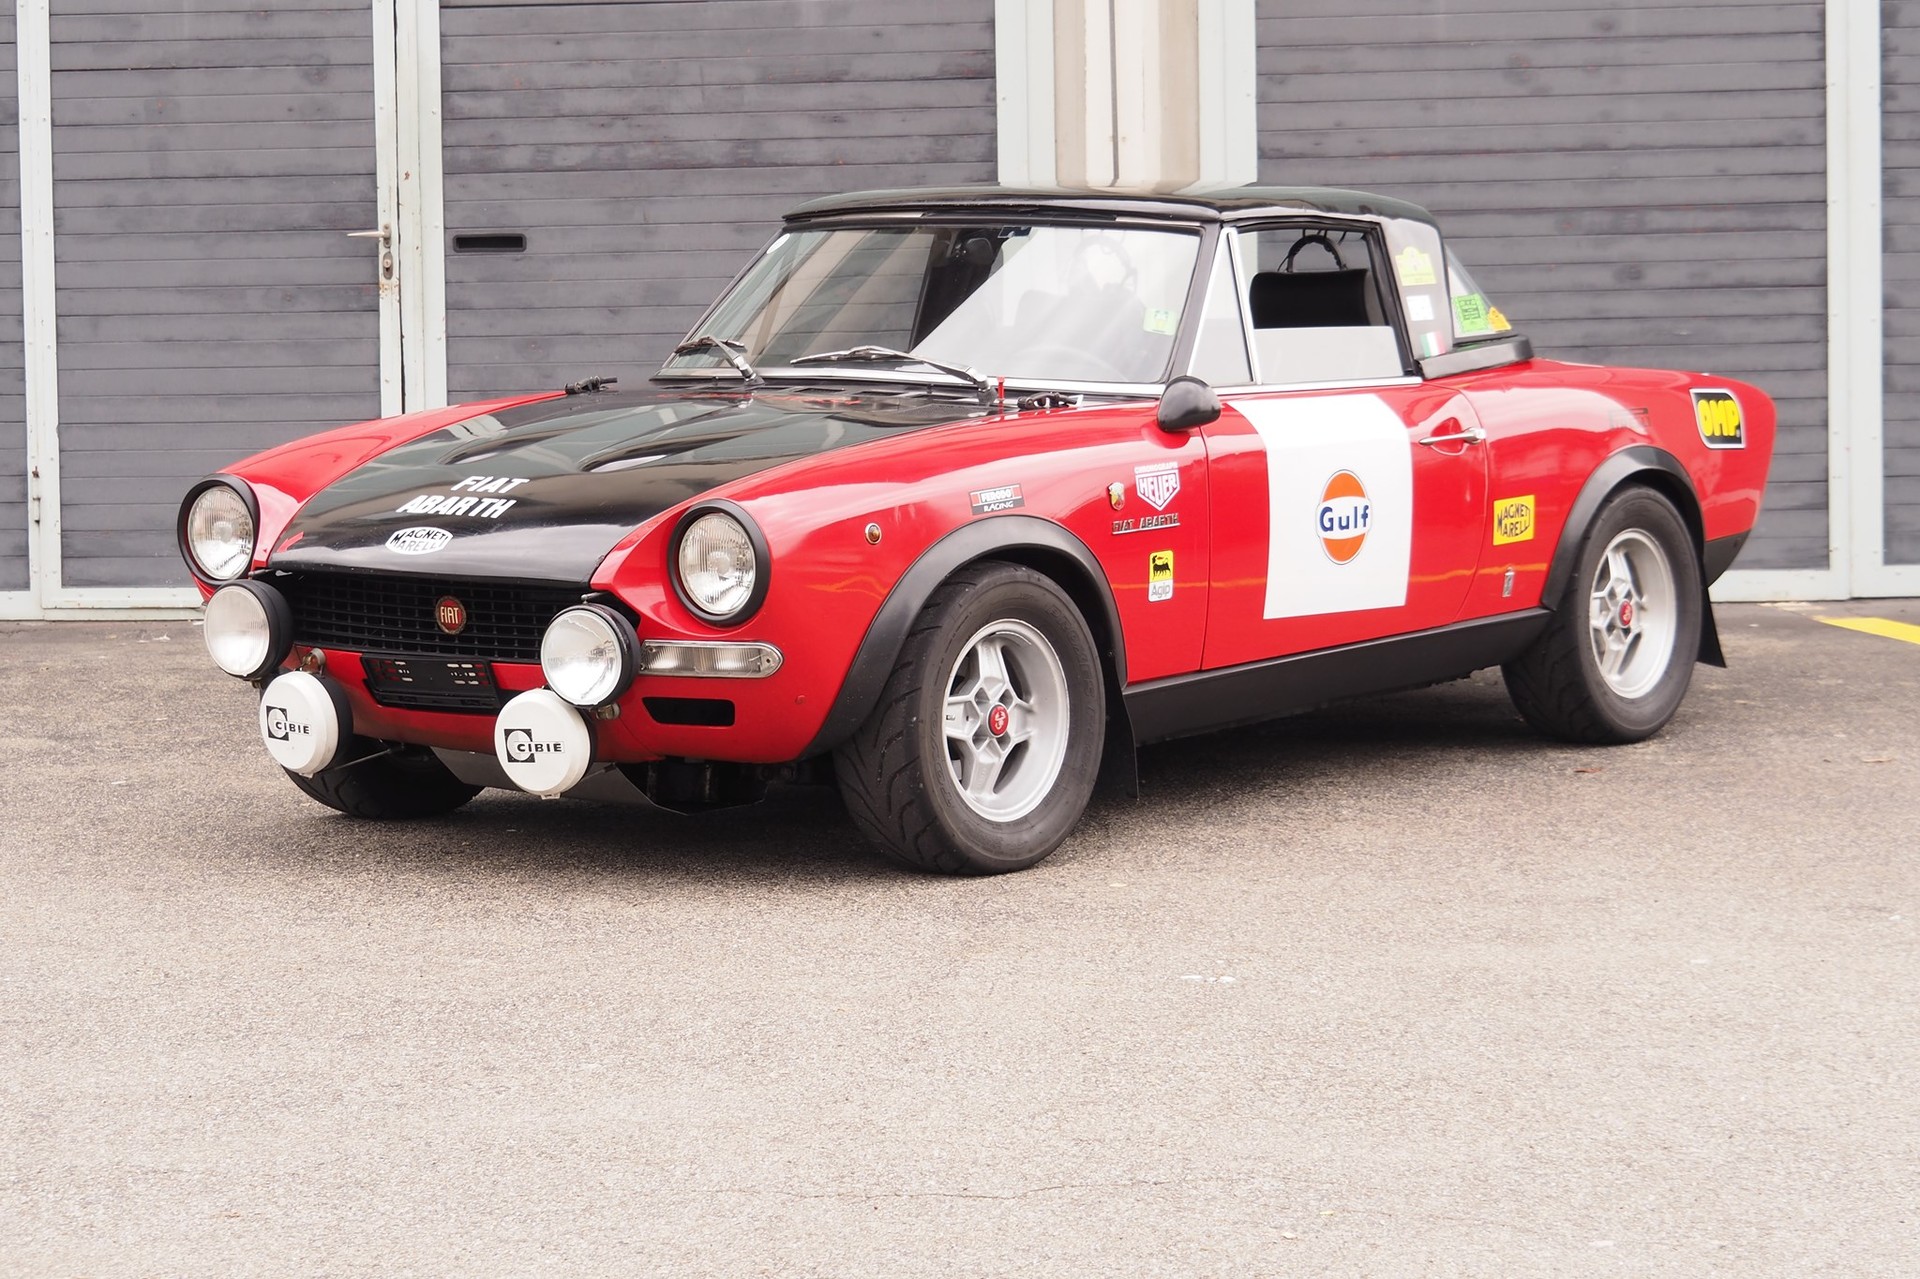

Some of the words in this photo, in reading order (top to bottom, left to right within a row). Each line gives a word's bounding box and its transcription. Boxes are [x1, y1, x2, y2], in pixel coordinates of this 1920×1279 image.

[1697, 400, 1740, 437] OMP
[450, 475, 530, 494] FIAT
[1138, 474, 1178, 508] HEUER
[396, 494, 517, 519] ABARTH
[983, 501, 1014, 512] RACING
[1112, 519, 1135, 532] FIAT
[1139, 513, 1179, 530] ABARTH
[1319, 504, 1370, 533] Gulf
[1151, 583, 1171, 599] Agip
[440, 606, 459, 624] FIAT
[275, 721, 310, 735] CIBIE
[516, 743, 562, 753] CIBIE
